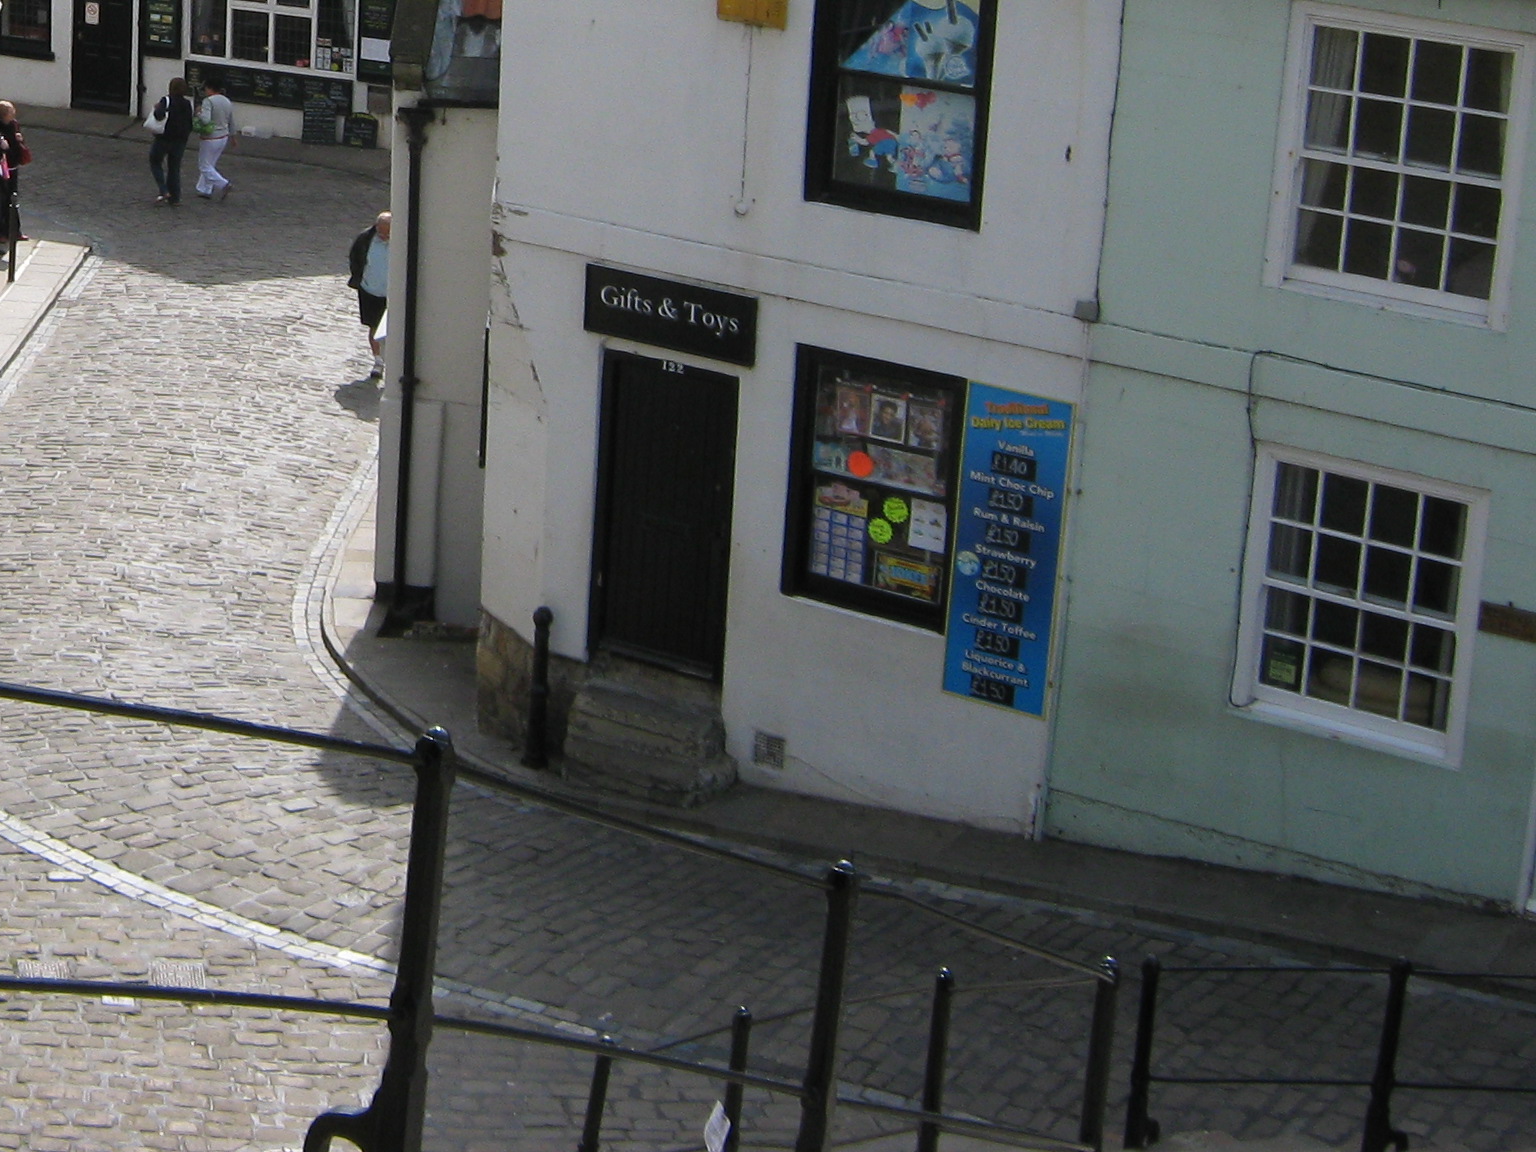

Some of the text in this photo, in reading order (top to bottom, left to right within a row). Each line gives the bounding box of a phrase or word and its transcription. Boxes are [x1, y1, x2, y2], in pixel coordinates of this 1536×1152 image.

[600, 285, 740, 335] Gifts & Toys
[662, 360, 685, 375] 122
[971, 415, 1066, 431] Dairy Ice Cream
[998, 440, 1035, 457] Vanilla
[969, 470, 1055, 501] Mint Choc Chip
[973, 506, 1046, 534] Rum & Raisin
[975, 543, 1038, 569] Strawberry
[975, 580, 1031, 602] Chocolate
[962, 612, 1037, 641] Cinder Toffee
[961, 661, 1031, 688] Blackcurrant
[964, 649, 1027, 674] Liquorice &
